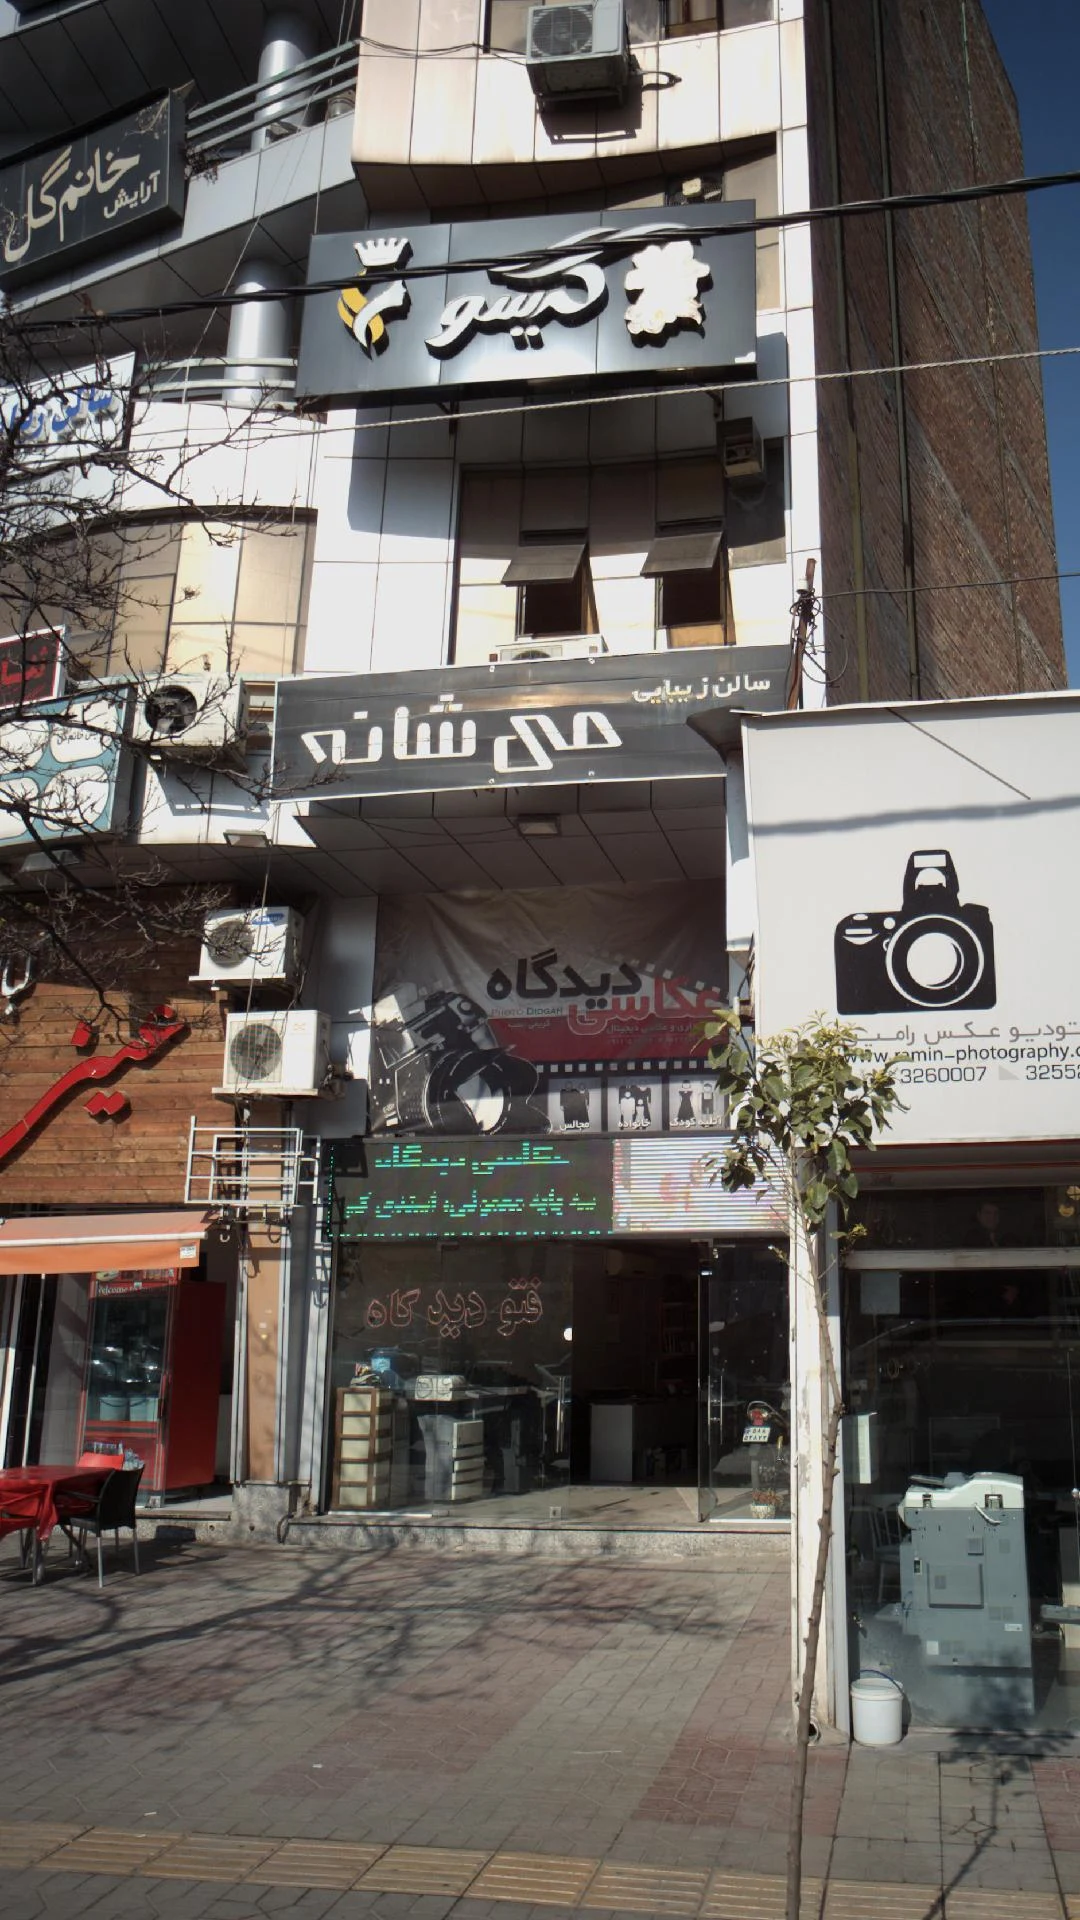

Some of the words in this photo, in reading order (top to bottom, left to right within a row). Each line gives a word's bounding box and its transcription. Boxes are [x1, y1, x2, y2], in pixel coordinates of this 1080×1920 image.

[103, 169, 161, 219] آرایش
[425, 222, 690, 350] گیسو
[631, 676, 709, 704] زیبایی
[712, 673, 771, 698] سالن
[486, 948, 644, 1010] دیدگاه
[567, 975, 725, 1036] عکاسی
[924, 1021, 1000, 1046] عکس
[901, 1066, 987, 1084] 3260007
[1026, 1064, 1080, 1081] 3255
[560, 1119, 590, 1132] مجالس
[618, 1118, 651, 1130] خانواده
[669, 1116, 696, 1129] کودک
